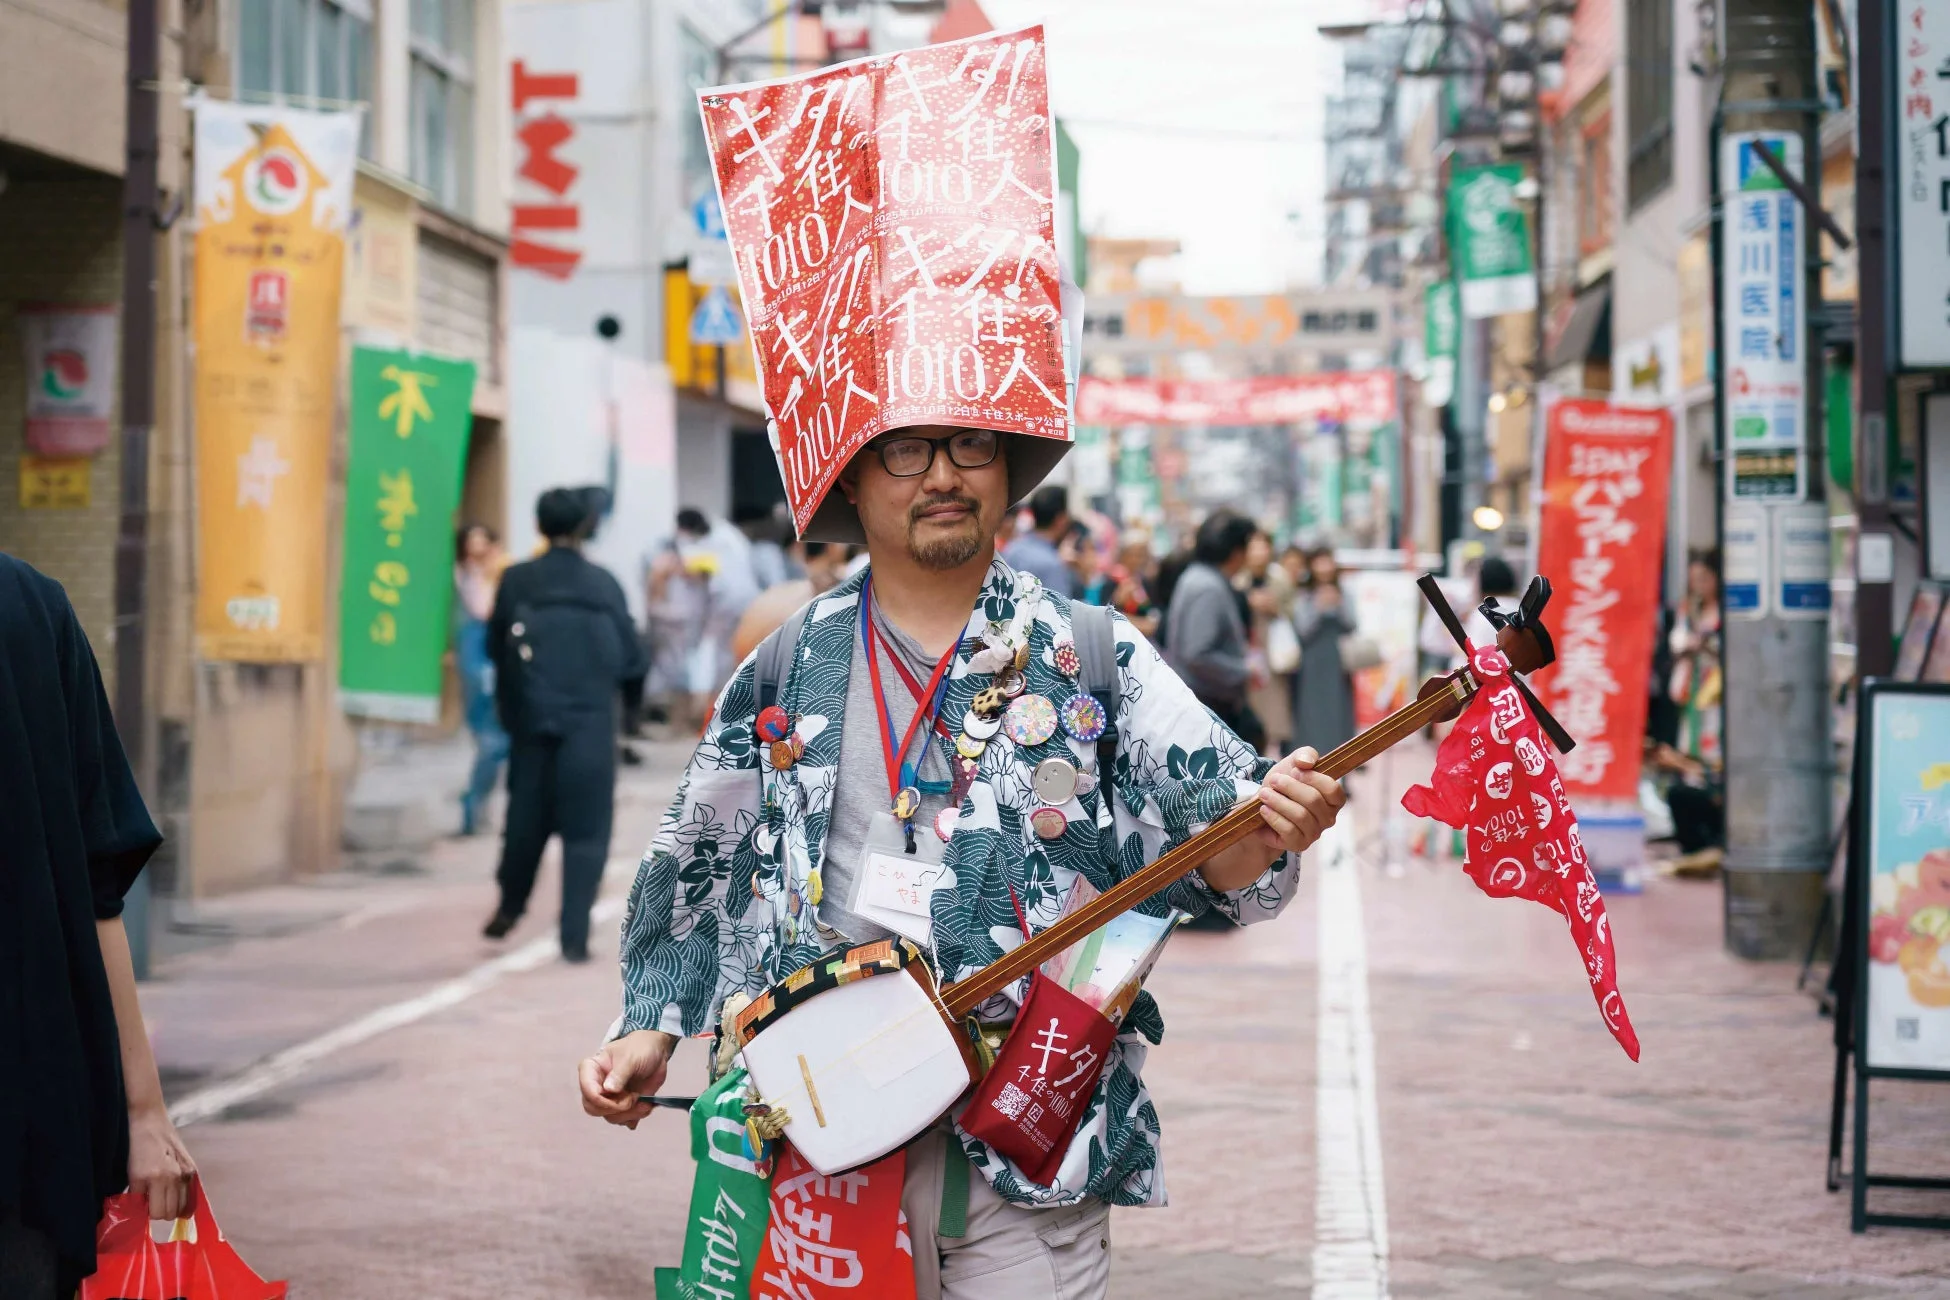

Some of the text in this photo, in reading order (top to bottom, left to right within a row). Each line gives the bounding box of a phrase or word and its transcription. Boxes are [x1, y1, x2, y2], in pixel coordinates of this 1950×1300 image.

[872, 109, 1046, 164] 千住の
[876, 159, 1054, 209] 1010人
[745, 185, 873, 298] 1010人
[878, 287, 1057, 346] 千住の
[884, 342, 1067, 410] 1010人
[788, 370, 879, 505] 1010人
[982, 409, 1065, 428] 千住スポーツ公園
[1474, 805, 1525, 837] 1010人
